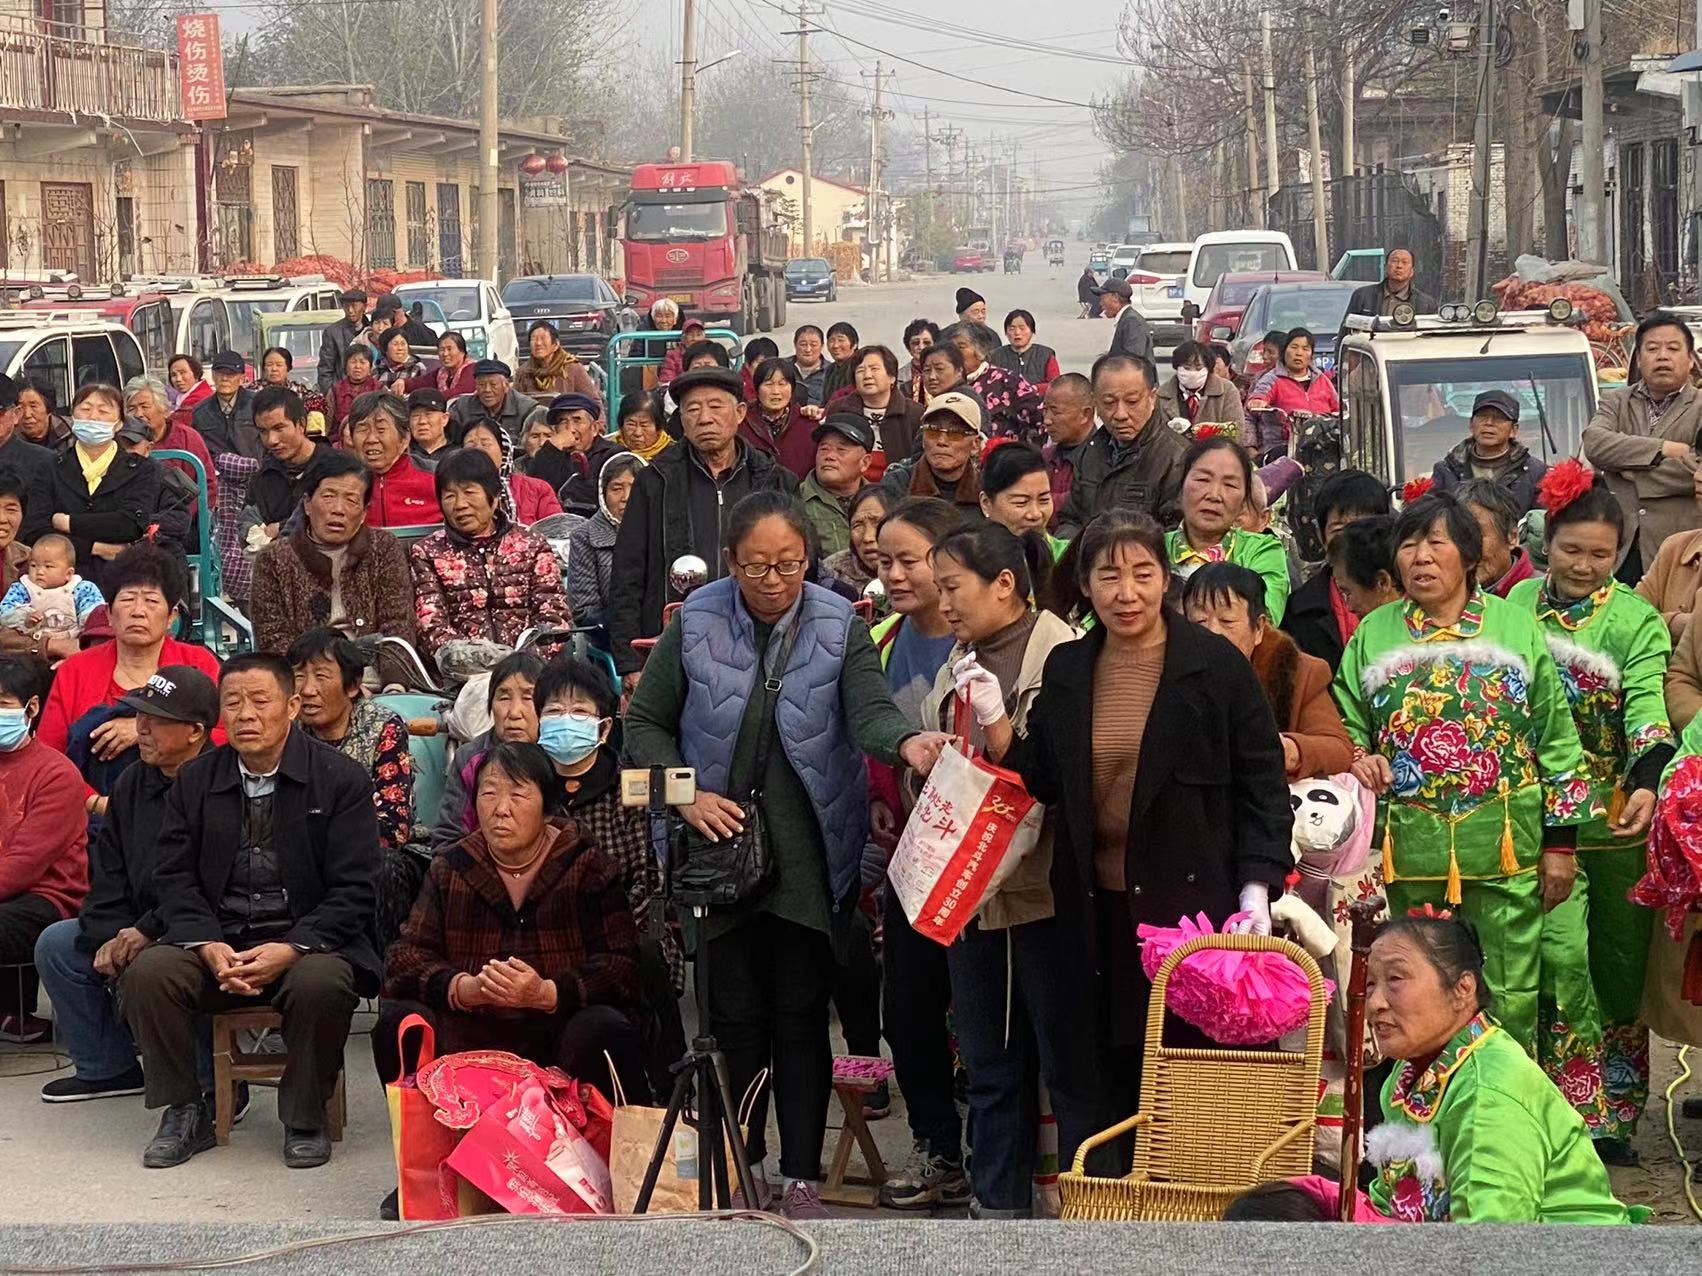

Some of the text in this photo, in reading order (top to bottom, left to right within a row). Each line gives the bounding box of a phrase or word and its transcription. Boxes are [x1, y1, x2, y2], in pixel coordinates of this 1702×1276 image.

[182, 18, 209, 104] 烧伤烫伤
[933, 822, 998, 926] 庆祝北斗汽车创立30周年
